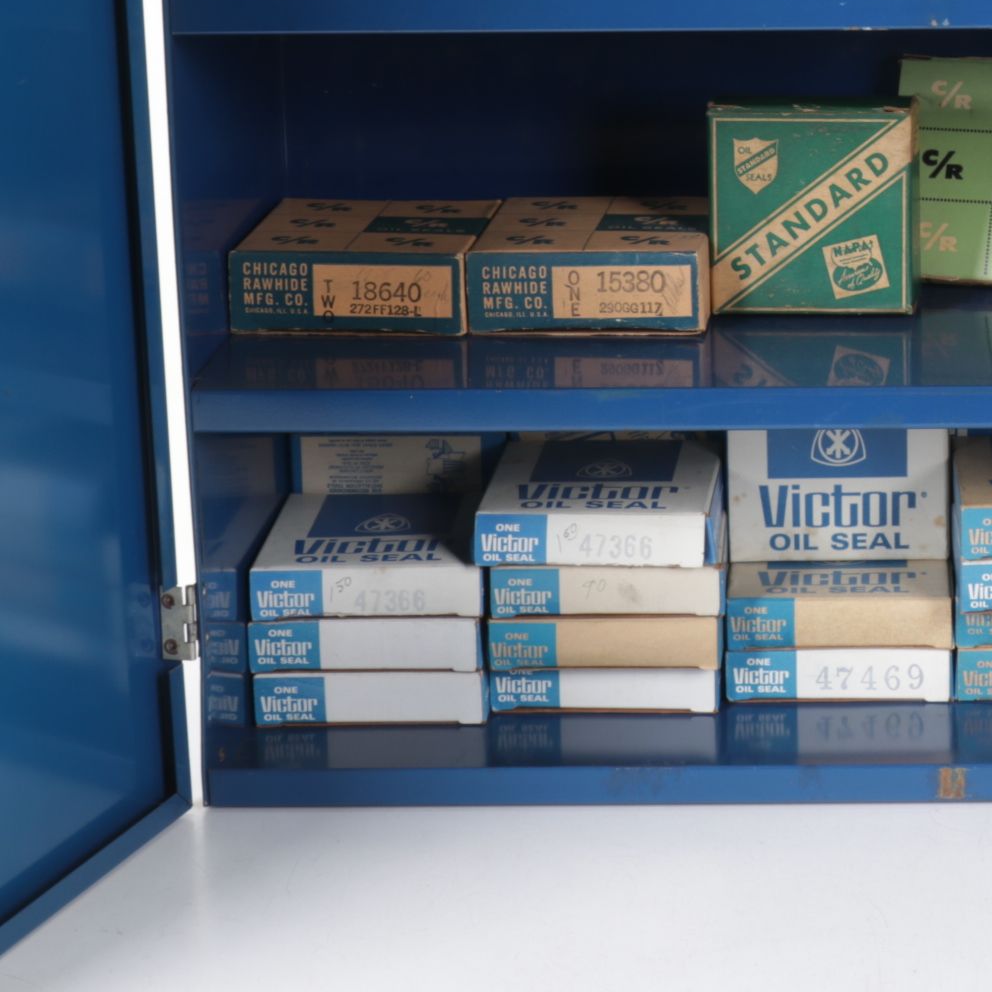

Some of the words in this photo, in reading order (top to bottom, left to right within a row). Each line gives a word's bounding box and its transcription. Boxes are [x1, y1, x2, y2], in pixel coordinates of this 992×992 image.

[744, 172, 773, 183] SEALS
[730, 151, 889, 281] STANDARD
[242, 261, 308, 276] CHICAGO
[481, 265, 548, 279] CHICAGO
[243, 278, 308, 291] RAWHIDE
[483, 281, 548, 295] RAWHIDE
[596, 269, 666, 294] 15380
[243, 293, 280, 306] MFG.
[285, 293, 308, 306] CO.
[351, 279, 422, 303] 18640
[483, 296, 519, 310] MFG.
[525, 296, 548, 310] CO.
[758, 484, 917, 528] Victor
[495, 523, 520, 532] ONE
[481, 534, 539, 552] Victor
[580, 534, 652, 558] 47366
[769, 533, 819, 551] OIL
[831, 532, 910, 550] SEAL
[256, 591, 316, 608] Victor
[354, 589, 426, 612] 47366
[494, 588, 552, 606] Victor
[268, 629, 292, 638] ONE
[255, 639, 312, 656] Victor
[746, 658, 771, 666] ONE
[733, 668, 790, 685] Victor
[816, 664, 924, 690] 47469
[274, 686, 298, 694] ONE
[495, 677, 552, 694] Victor
[260, 696, 318, 713] Victor
